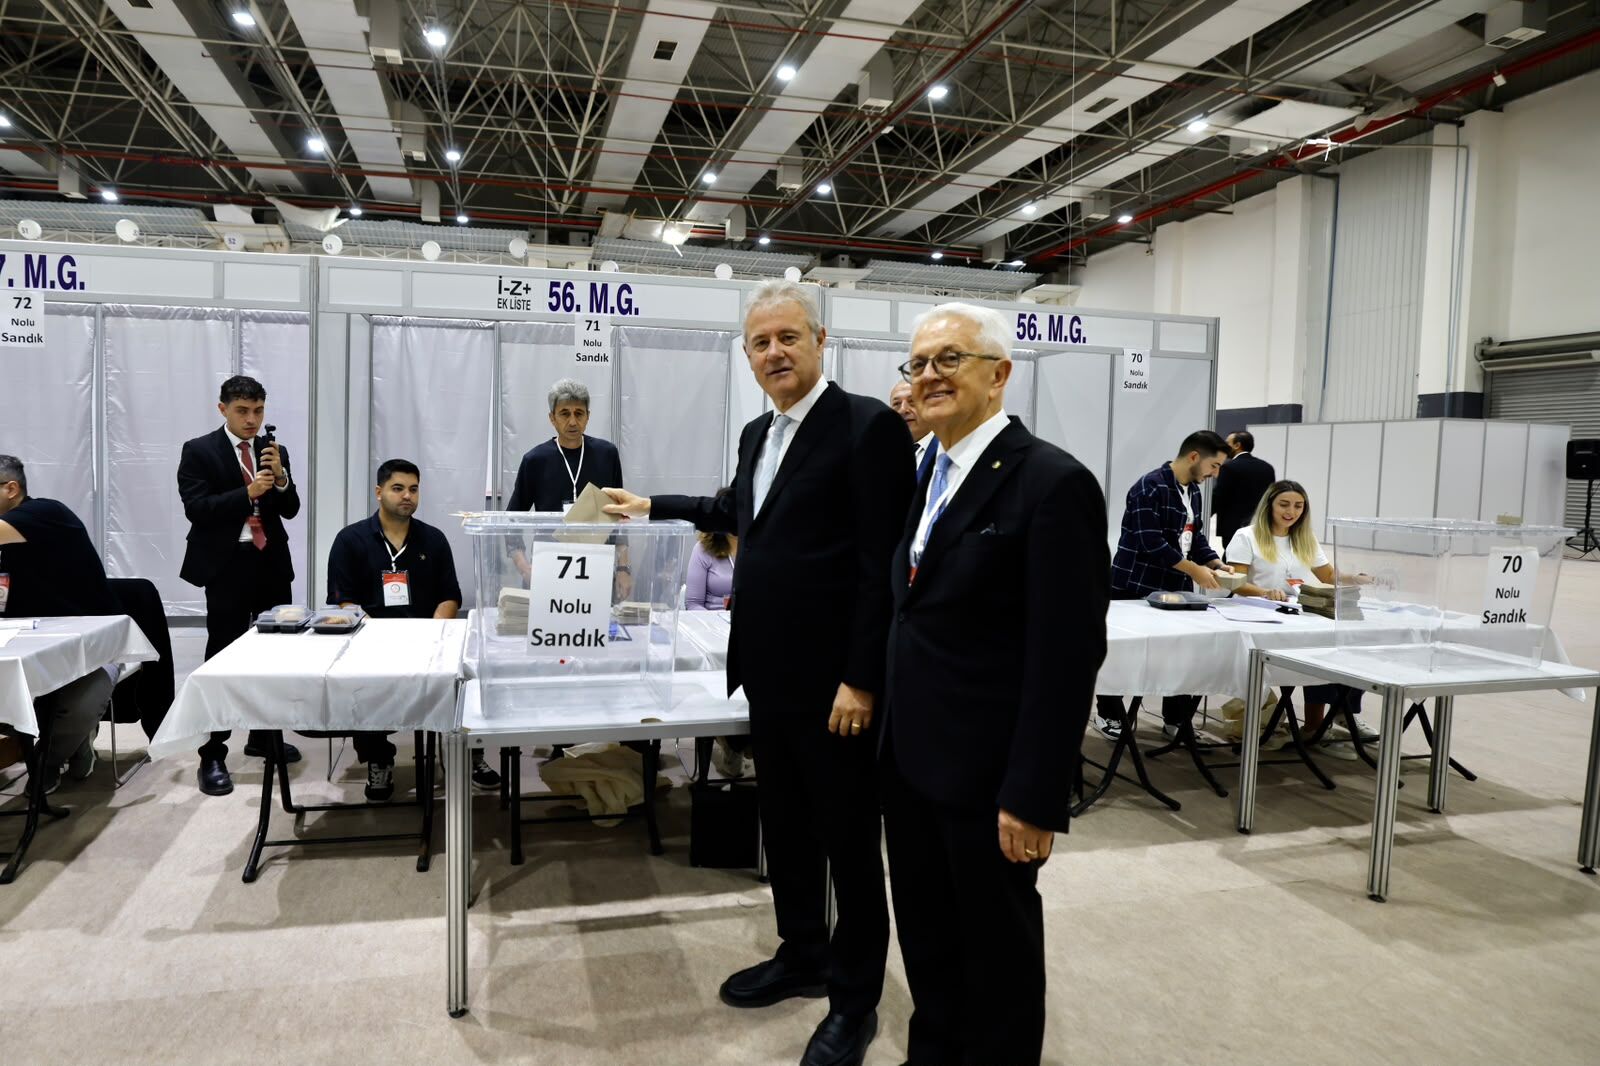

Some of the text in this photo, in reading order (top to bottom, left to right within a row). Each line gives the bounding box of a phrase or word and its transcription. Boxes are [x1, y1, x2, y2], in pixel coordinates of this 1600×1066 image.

[25, 254, 85, 290] M.G.
[13, 296, 32, 309] 72
[497, 296, 531, 311] EK LİSTE
[548, 281, 580, 312] 56.
[589, 282, 639, 315] M.G.
[11, 318, 35, 327] Nolu
[585, 320, 600, 331] 71
[1016, 313, 1087, 344] 56. M.G.
[1, 332, 43, 343] Sandık
[583, 339, 602, 347] Nolu
[575, 353, 609, 363] Sandık
[1131, 353, 1143, 363] 70
[1130, 369, 1144, 377] Nolu
[1123, 380, 1148, 390] Sandık
[557, 555, 590, 580] 71
[1501, 555, 1522, 573] 70
[1495, 587, 1520, 599] Nolu
[549, 599, 592, 614] Nolu
[1482, 608, 1527, 624] Sandık
[531, 628, 606, 647] Sandık
